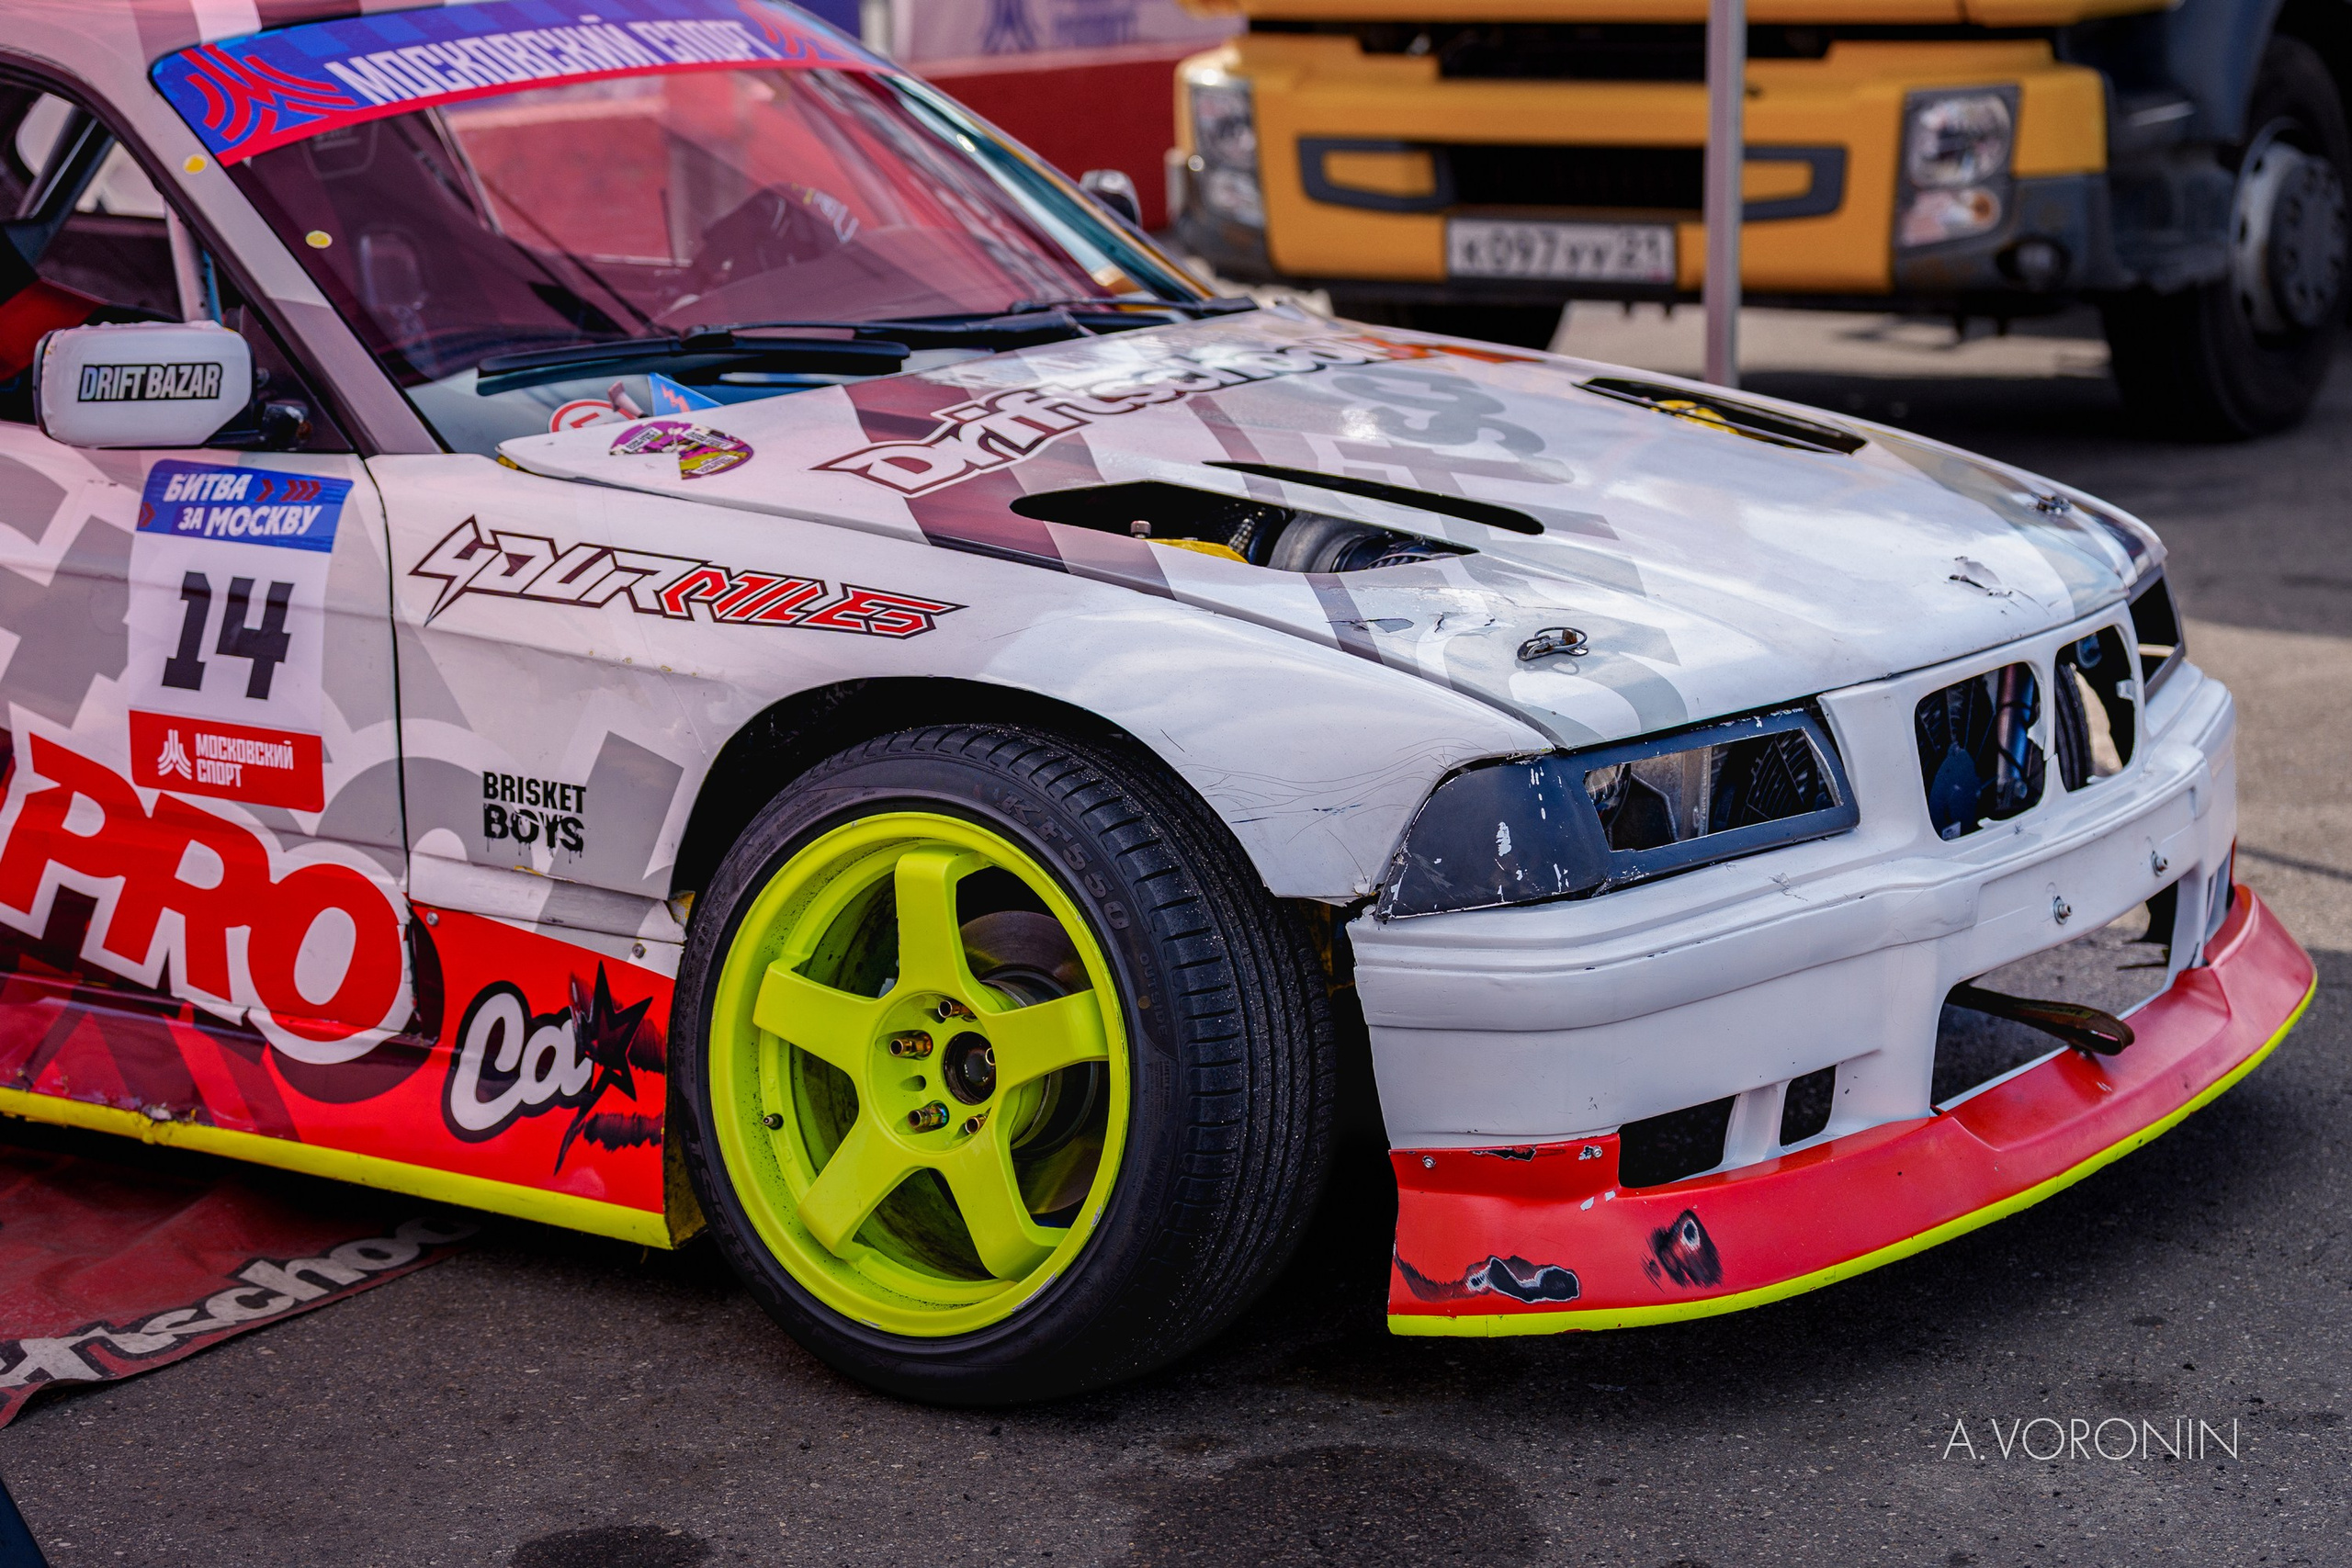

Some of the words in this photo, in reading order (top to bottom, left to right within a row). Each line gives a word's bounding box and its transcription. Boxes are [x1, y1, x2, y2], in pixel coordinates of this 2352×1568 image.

[324, 15, 647, 106] МОСКОВСКИЙ
[630, 20, 783, 67] СПОРТ
[79, 366, 147, 401] DRIFT
[144, 364, 221, 400] BAZAR
[163, 473, 253, 502] БИТВА
[177, 506, 206, 531] ЗА
[203, 505, 323, 537] МОСКВУ
[162, 570, 294, 700] 14
[195, 732, 294, 771] МОСКОВСКИЙ
[196, 758, 243, 788] СПОРТ
[483, 771, 586, 814] BRISKET
[483, 802, 584, 856] BOYS
[996, 789, 1131, 931] KF550
[0, 732, 404, 1043] PRO
[1138, 952, 1169, 1037] OUTSIDE
